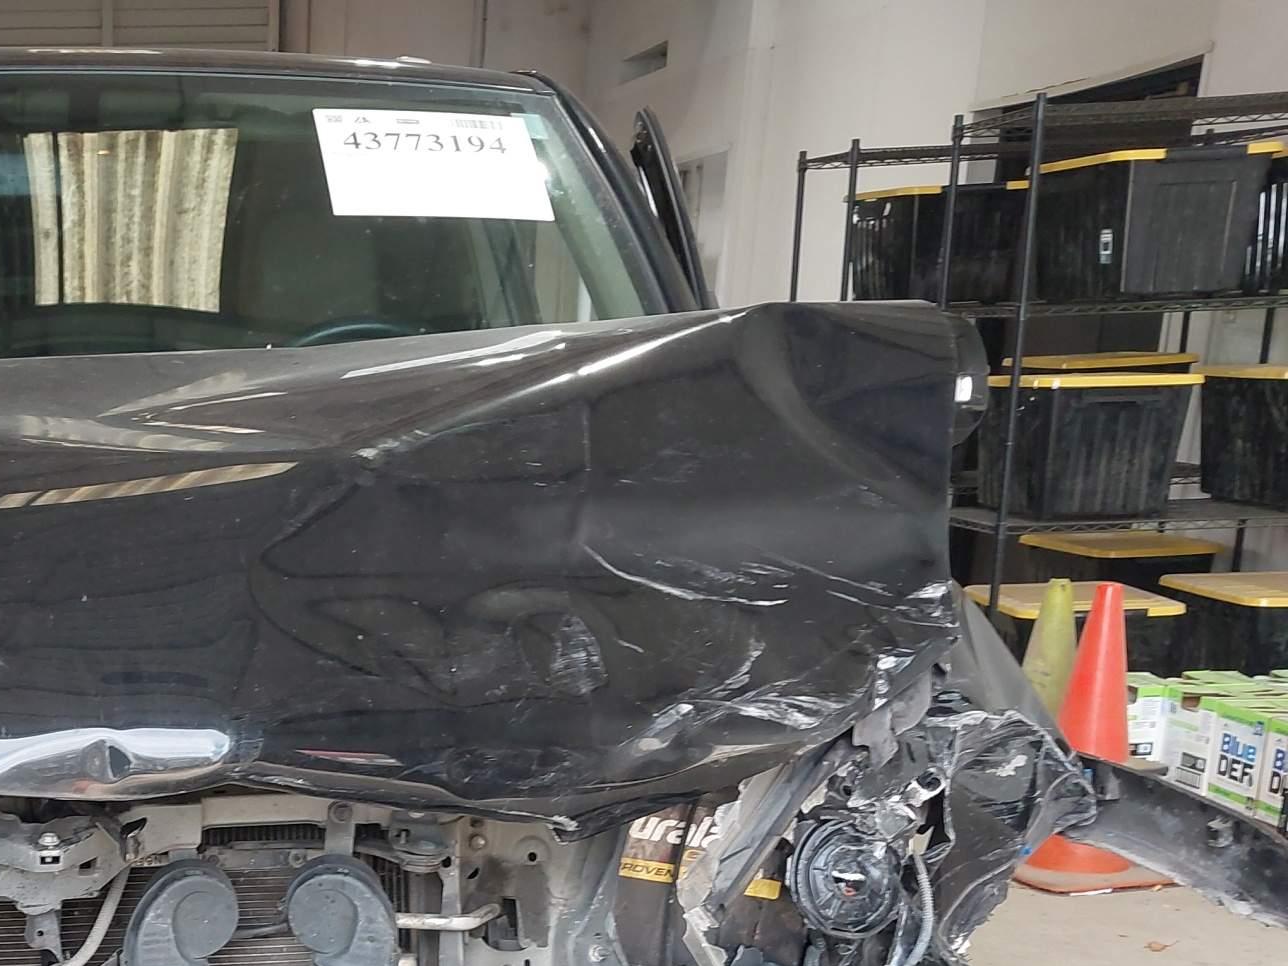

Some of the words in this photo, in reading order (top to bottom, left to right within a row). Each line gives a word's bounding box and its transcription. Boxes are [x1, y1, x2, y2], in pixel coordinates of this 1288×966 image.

[343, 131, 507, 154] 43773194
[1221, 733, 1256, 763] Blue
[1216, 754, 1255, 787] DEF
[628, 816, 720, 849] urala
[620, 861, 674, 879] ROVEN
